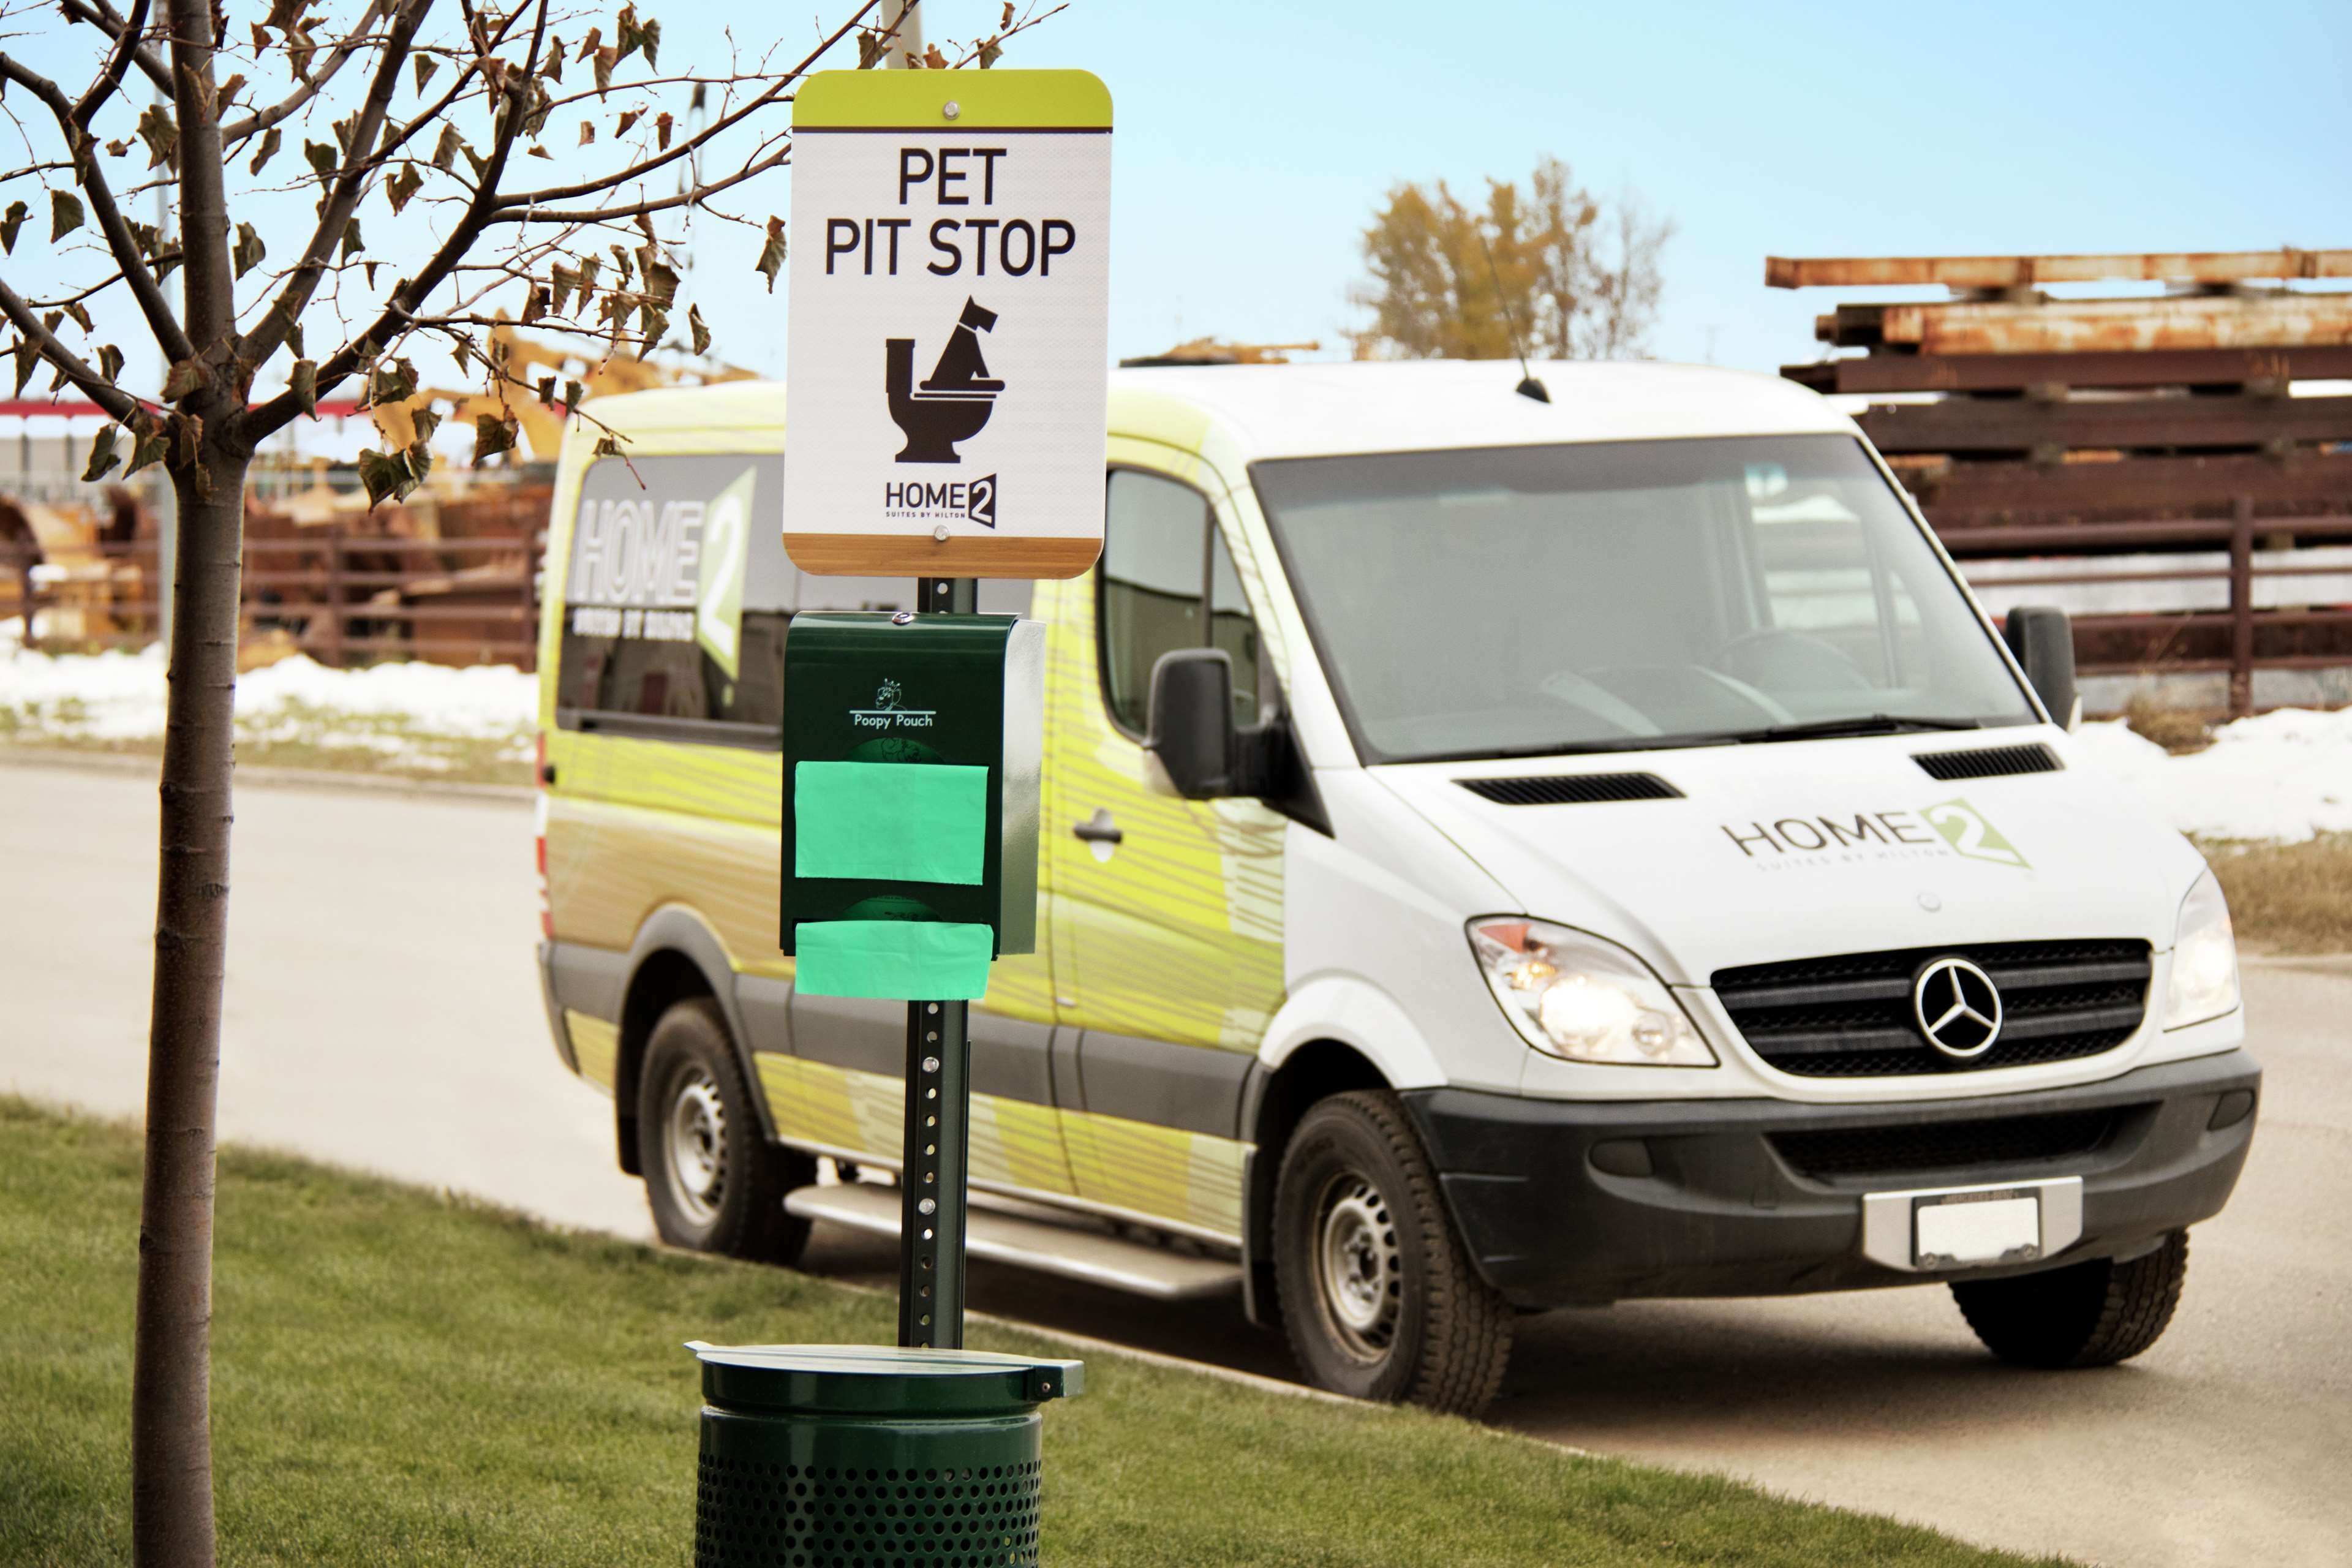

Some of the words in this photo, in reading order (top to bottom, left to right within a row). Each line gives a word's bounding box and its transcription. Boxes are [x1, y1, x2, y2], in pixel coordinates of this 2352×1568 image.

[899, 148, 1007, 205] PET
[826, 218, 911, 276] PIT
[927, 218, 1076, 277] STOP
[854, 714, 891, 729] Poopy
[896, 714, 933, 727] Pouch
